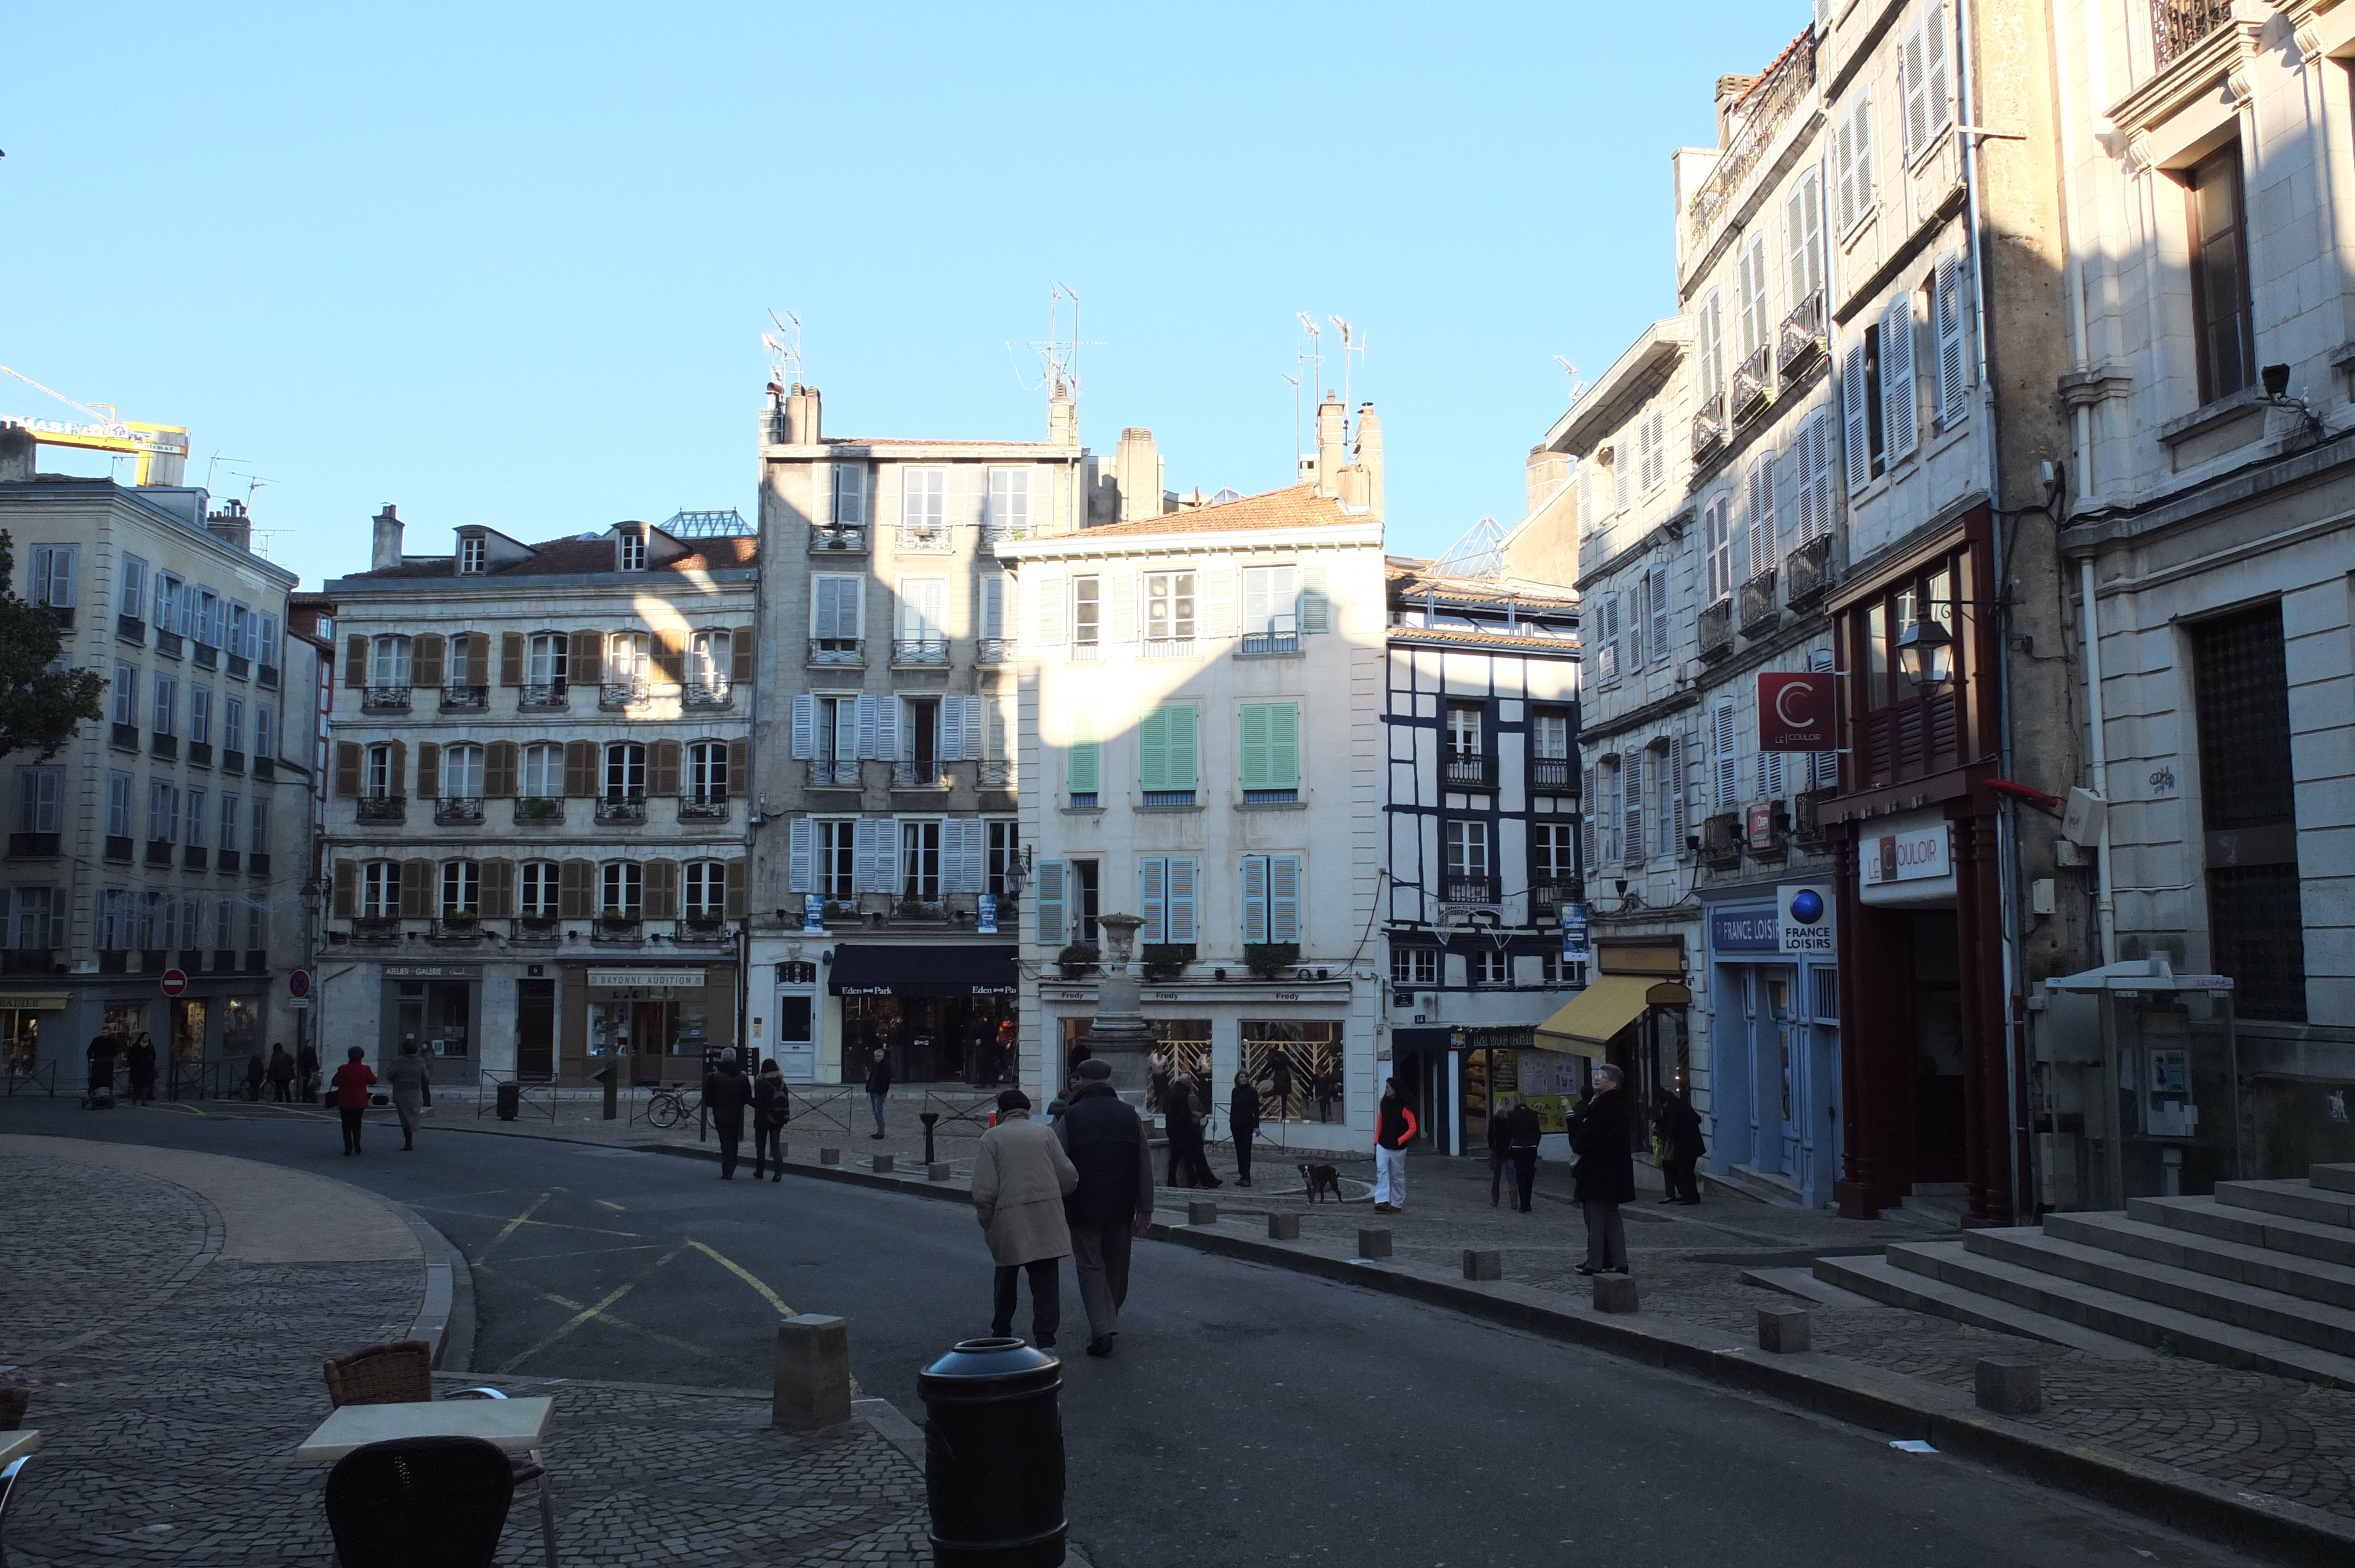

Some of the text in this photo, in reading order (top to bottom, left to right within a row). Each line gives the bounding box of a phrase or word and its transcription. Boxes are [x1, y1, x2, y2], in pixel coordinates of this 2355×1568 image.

[1868, 839, 1936, 879] LE COULOIR
[1723, 919, 1752, 941] FRANCE
[1786, 927, 1830, 938] FRANCE
[1786, 939, 1830, 949] LOISIRS
[647, 976, 692, 985] AUDITION
[842, 986, 893, 995] Eden Park
[972, 985, 992, 994] Eden
